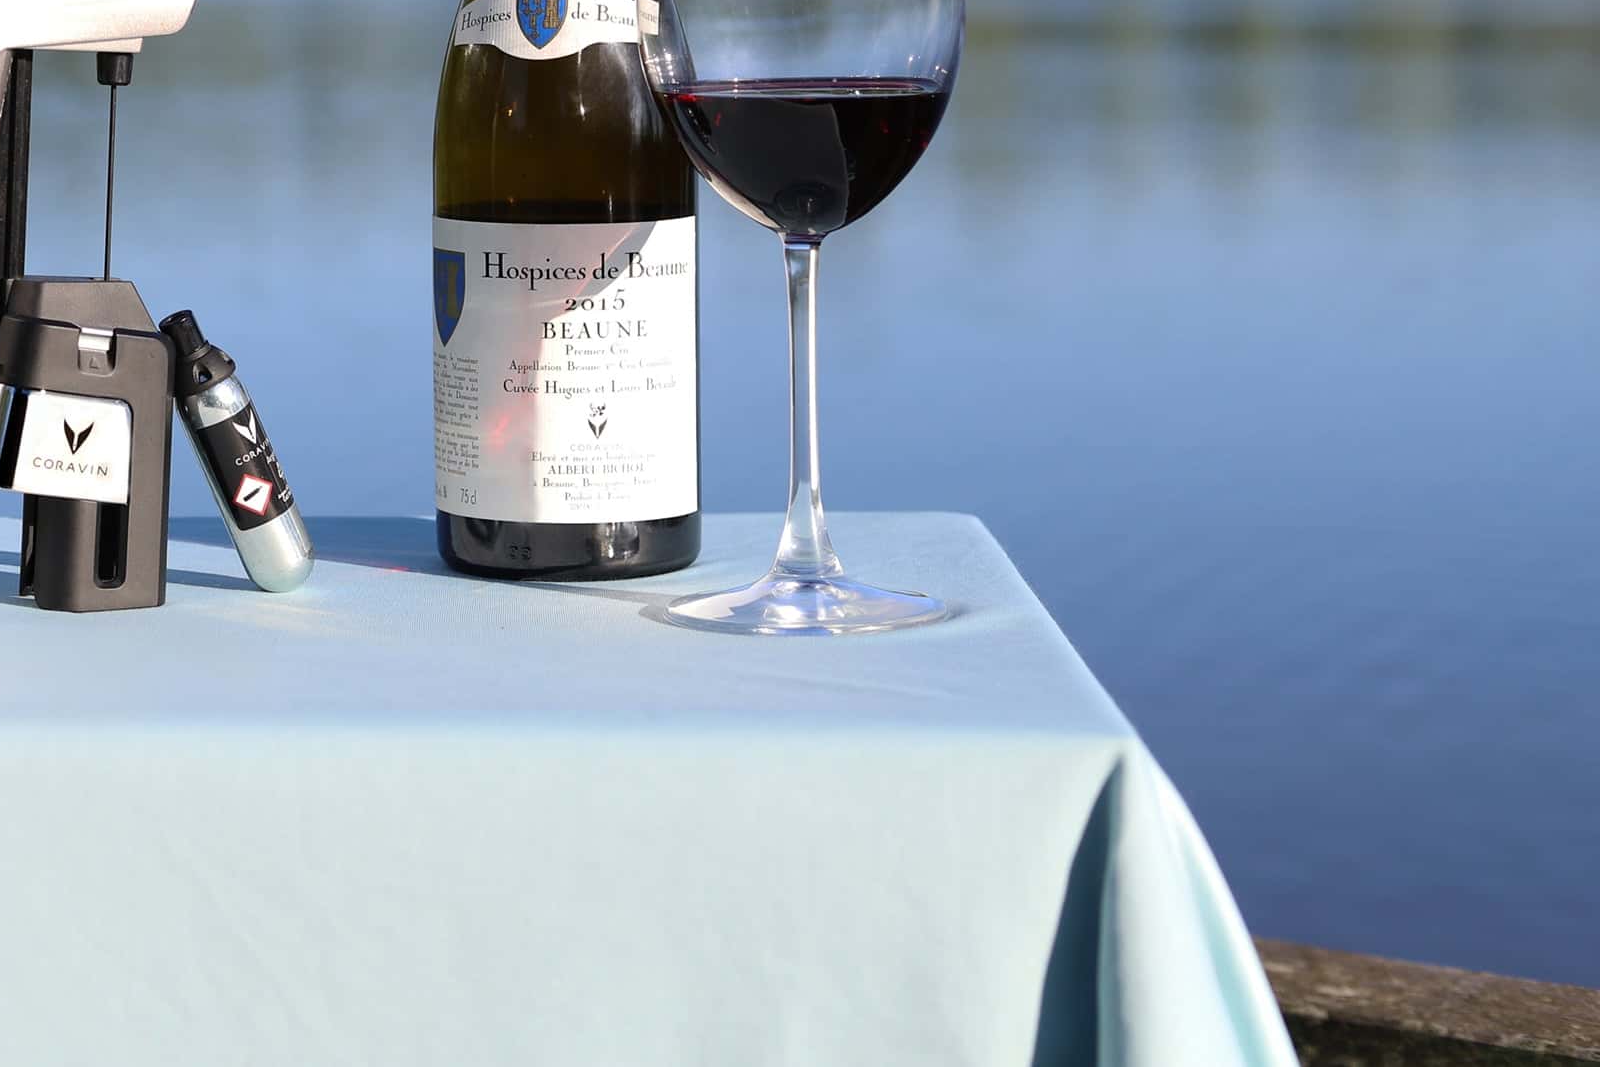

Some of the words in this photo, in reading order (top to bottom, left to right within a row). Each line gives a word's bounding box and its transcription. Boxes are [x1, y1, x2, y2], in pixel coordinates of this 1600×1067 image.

[461, 8, 512, 31] Hospices
[571, 2, 590, 20] de
[482, 251, 586, 291] Hospices
[593, 252, 619, 280] de
[625, 250, 688, 279] Beaune
[565, 288, 626, 311] 2015
[542, 320, 648, 339] BEAUNE
[509, 359, 562, 374] Appellation
[503, 378, 540, 394] Cuvée
[544, 380, 591, 399] Hugues
[32, 457, 109, 476] CORAVIN
